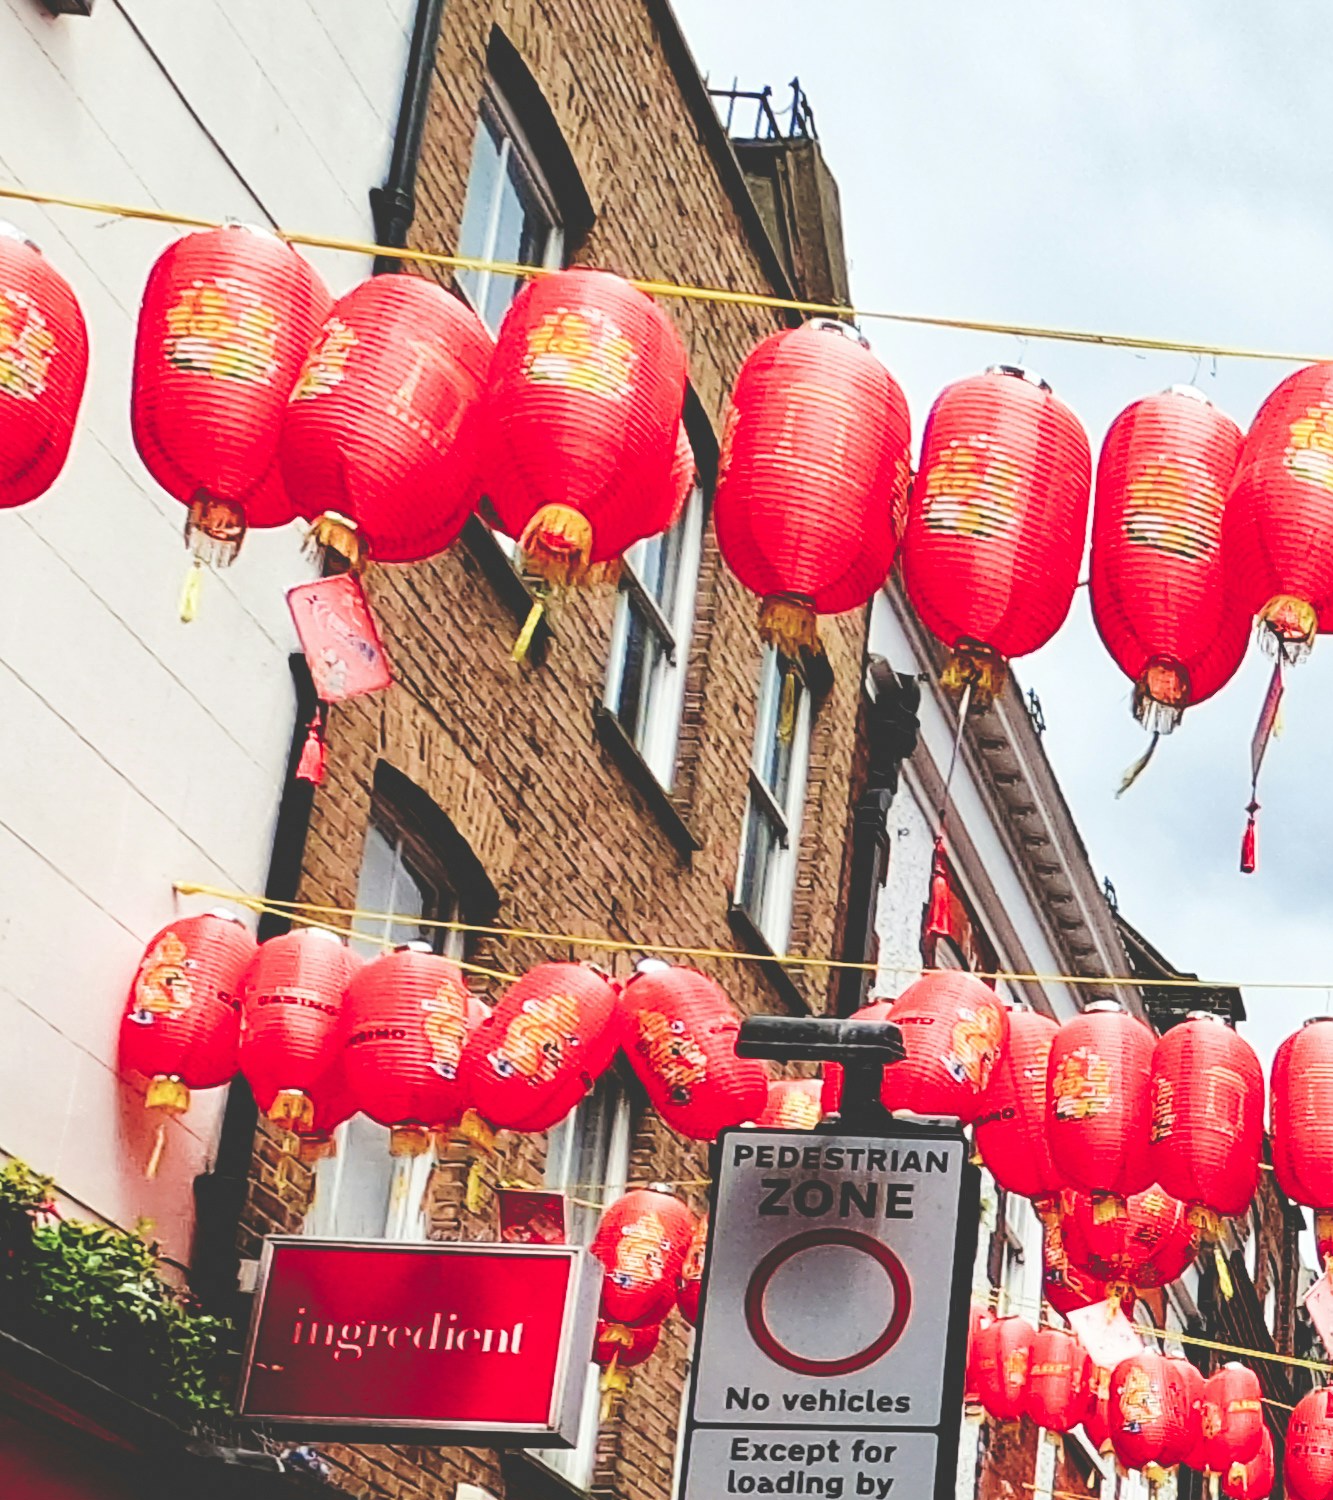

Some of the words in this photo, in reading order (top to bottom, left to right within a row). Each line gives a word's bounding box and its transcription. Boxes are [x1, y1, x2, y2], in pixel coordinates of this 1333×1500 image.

[733, 1145, 949, 1173] PEDESTRIAN
[758, 1178, 914, 1219] ZONE
[292, 1307, 524, 1361] ingredient
[726, 1387, 769, 1413] No
[781, 1388, 911, 1414] vehicles
[730, 1438, 840, 1465] Except
[851, 1440, 897, 1464] for
[727, 1470, 843, 1499] loading
[856, 1472, 894, 1500] by
